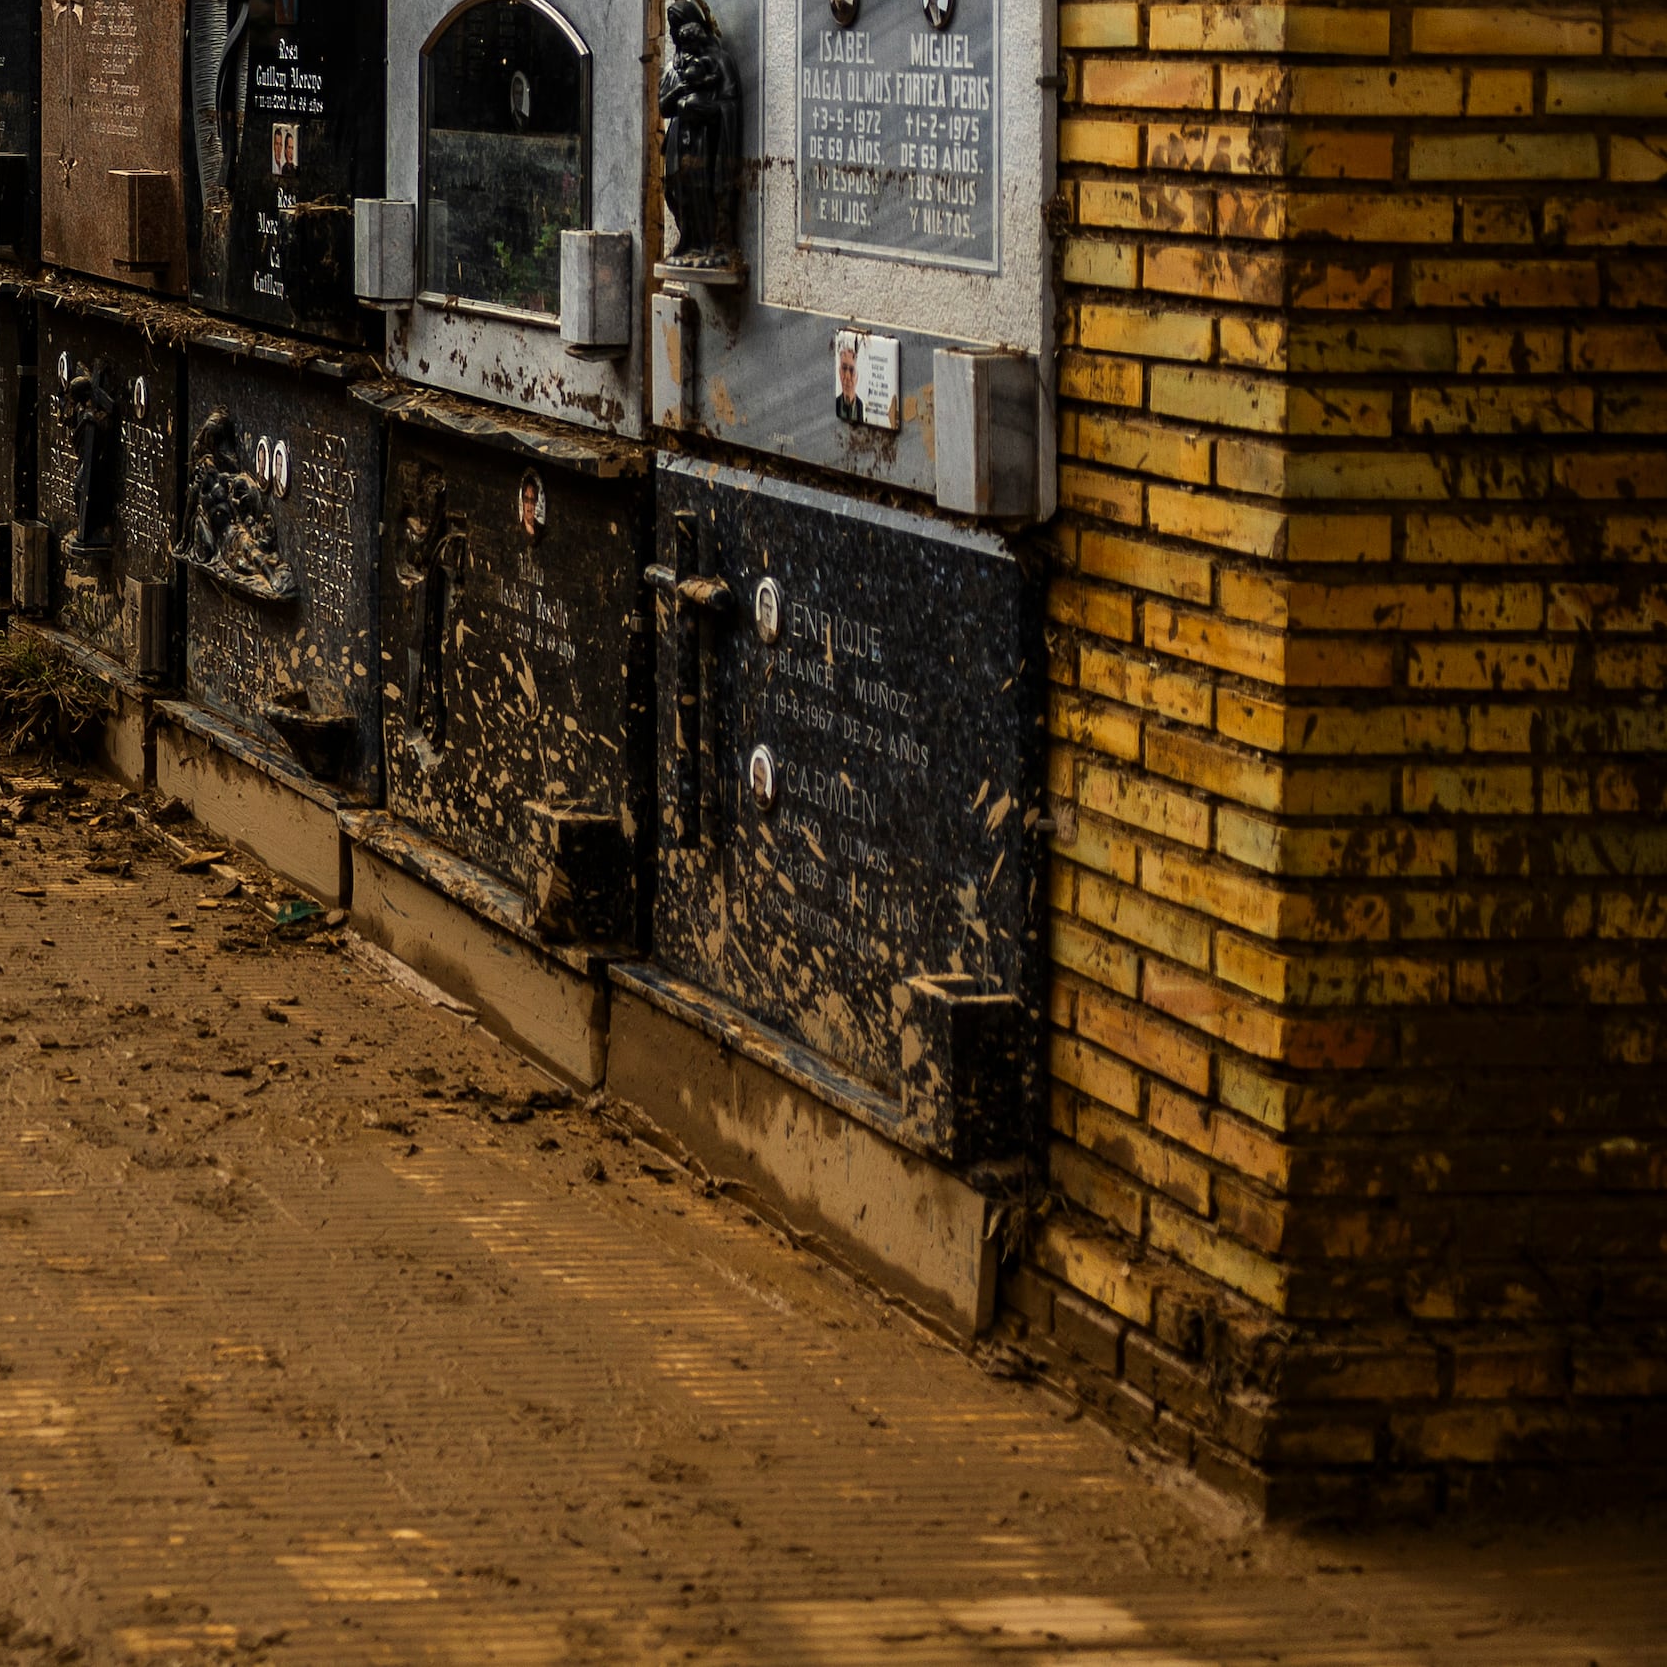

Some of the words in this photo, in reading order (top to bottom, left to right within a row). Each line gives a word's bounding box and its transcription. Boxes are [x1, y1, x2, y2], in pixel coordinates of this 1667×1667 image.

[278, 38, 298, 62] Rosa
[819, 30, 875, 64] ISABEL
[910, 33, 975, 69] MIGUEL
[803, 67, 843, 101] RAGA
[846, 70, 892, 104] OLMOS
[895, 72, 947, 108] FORTEA
[951, 75, 990, 111] PERIS
[810, 135, 824, 159] DE
[828, 137, 843, 161] 69
[847, 135, 885, 166] AÑOS.
[900, 142, 917, 167] DE
[921, 145, 938, 170] 69
[942, 142, 984, 174] AÑOS.
[907, 173, 933, 201] TUS
[937, 174, 977, 206] HIJOS
[789, 600, 883, 664] ENRIQUE
[778, 651, 835, 692] BLANCH
[854, 679, 909, 719] MUÑOZ
[842, 717, 861, 743] DE
[865, 724, 884, 753] 72
[888, 730, 929, 769] AÑOS
[786, 762, 878, 827] CARMEN
[838, 835, 888, 874] OLMOS
